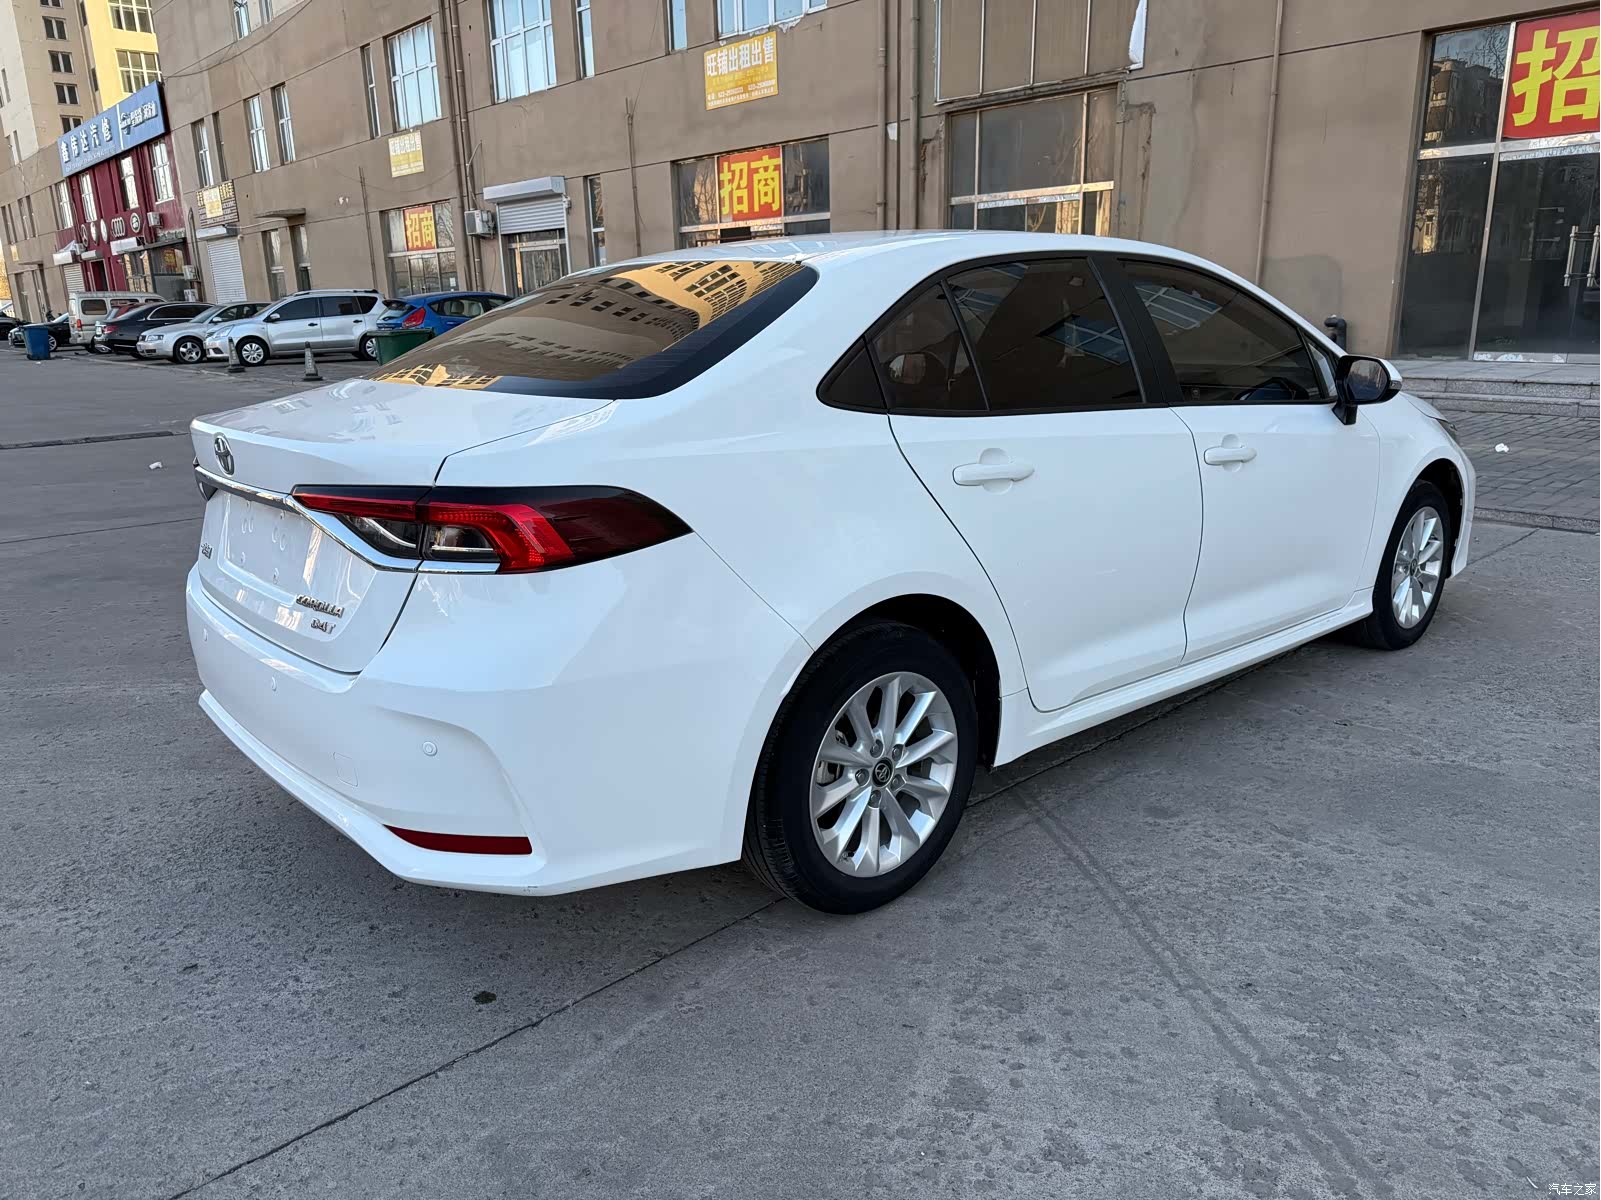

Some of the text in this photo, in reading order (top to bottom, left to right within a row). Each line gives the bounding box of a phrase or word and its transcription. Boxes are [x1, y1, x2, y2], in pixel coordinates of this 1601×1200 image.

[706, 36, 774, 77] 旺铺出租出售
[1512, 25, 1600, 127] 招
[719, 155, 781, 215] 招商
[406, 210, 437, 250] 招商
[296, 594, 345, 619] COROLLA
